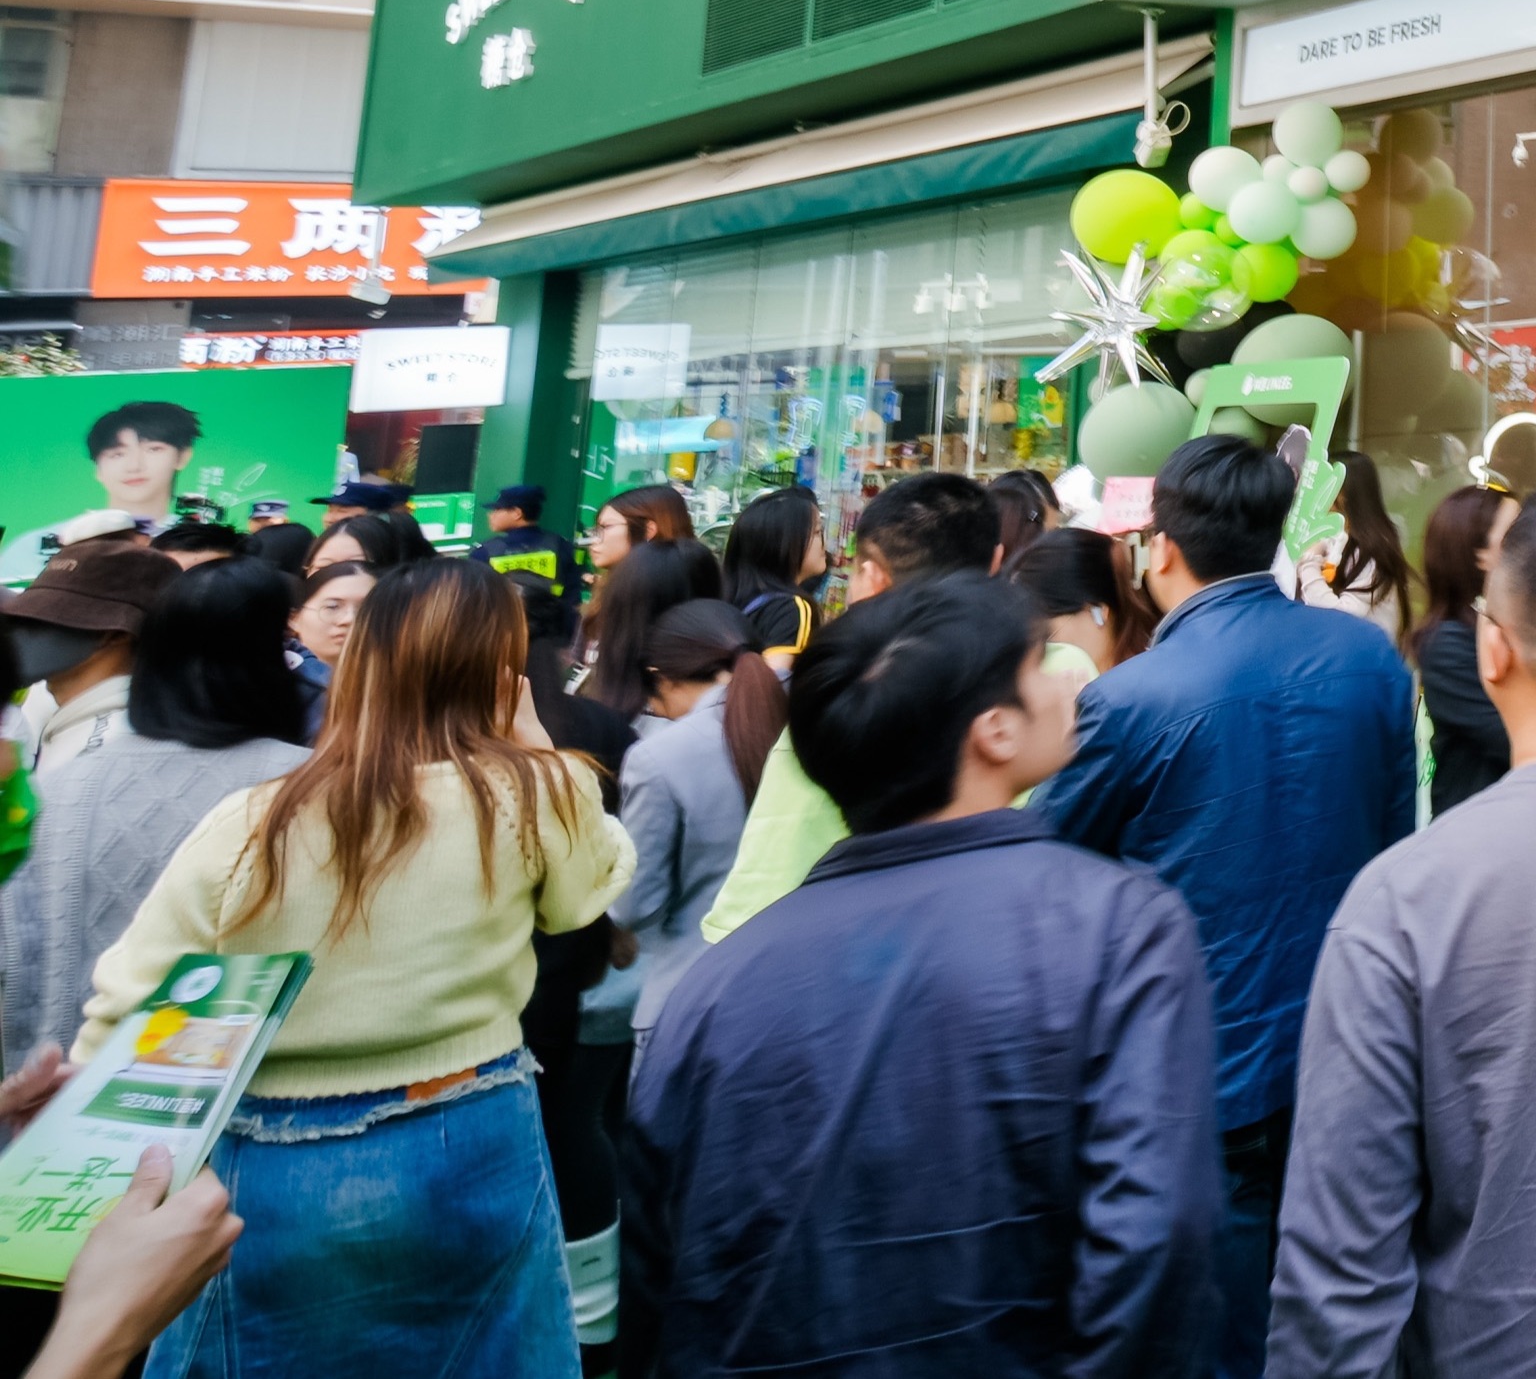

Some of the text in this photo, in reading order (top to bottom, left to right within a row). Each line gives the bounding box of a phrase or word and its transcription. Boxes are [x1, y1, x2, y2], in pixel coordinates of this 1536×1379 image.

[1298, 13, 1442, 64] DARE TO BE FRESH
[16, 1155, 134, 1192] 一送一!
